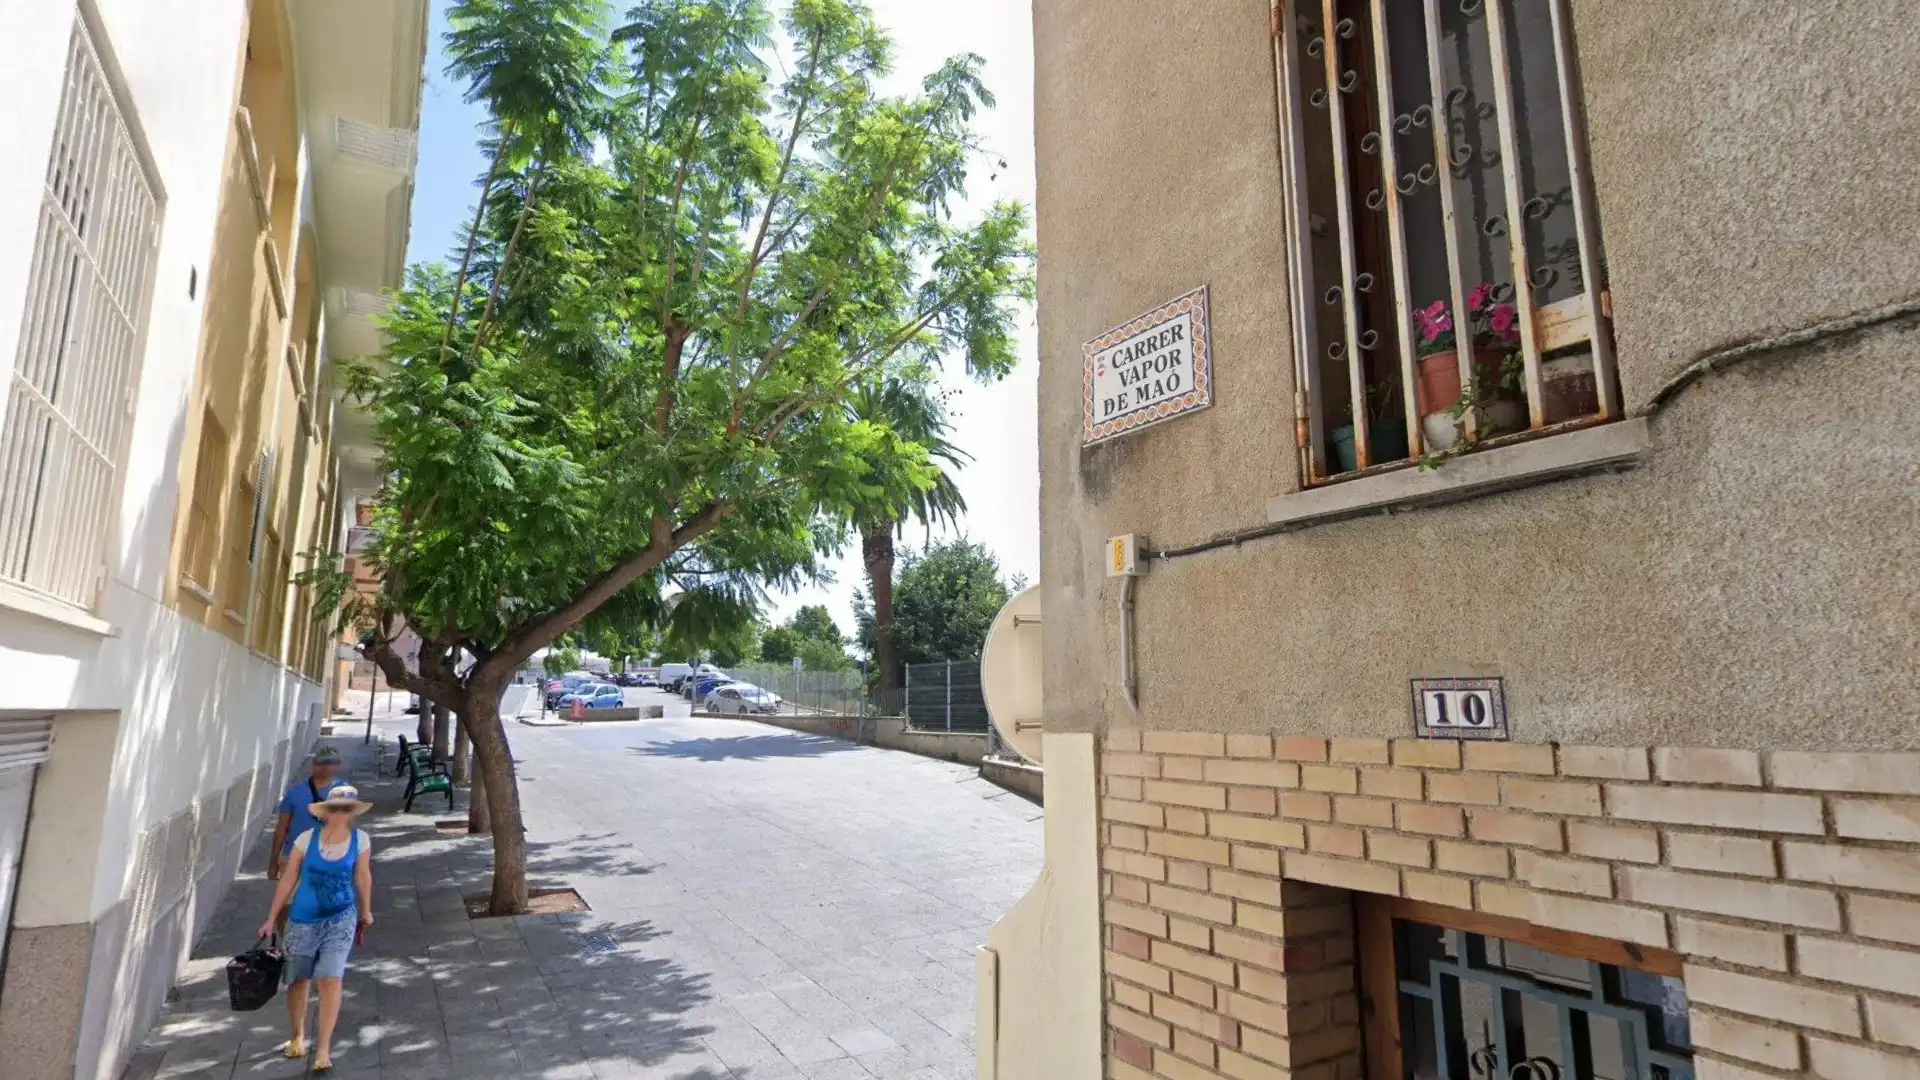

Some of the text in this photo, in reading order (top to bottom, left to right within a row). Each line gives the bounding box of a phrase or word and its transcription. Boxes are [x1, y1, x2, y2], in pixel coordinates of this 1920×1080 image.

[1111, 323, 1184, 369] CARRER
[1118, 348, 1182, 388] VAPOR
[1103, 369, 1181, 417] DE MAÓ
[1432, 692, 1486, 726] 10
